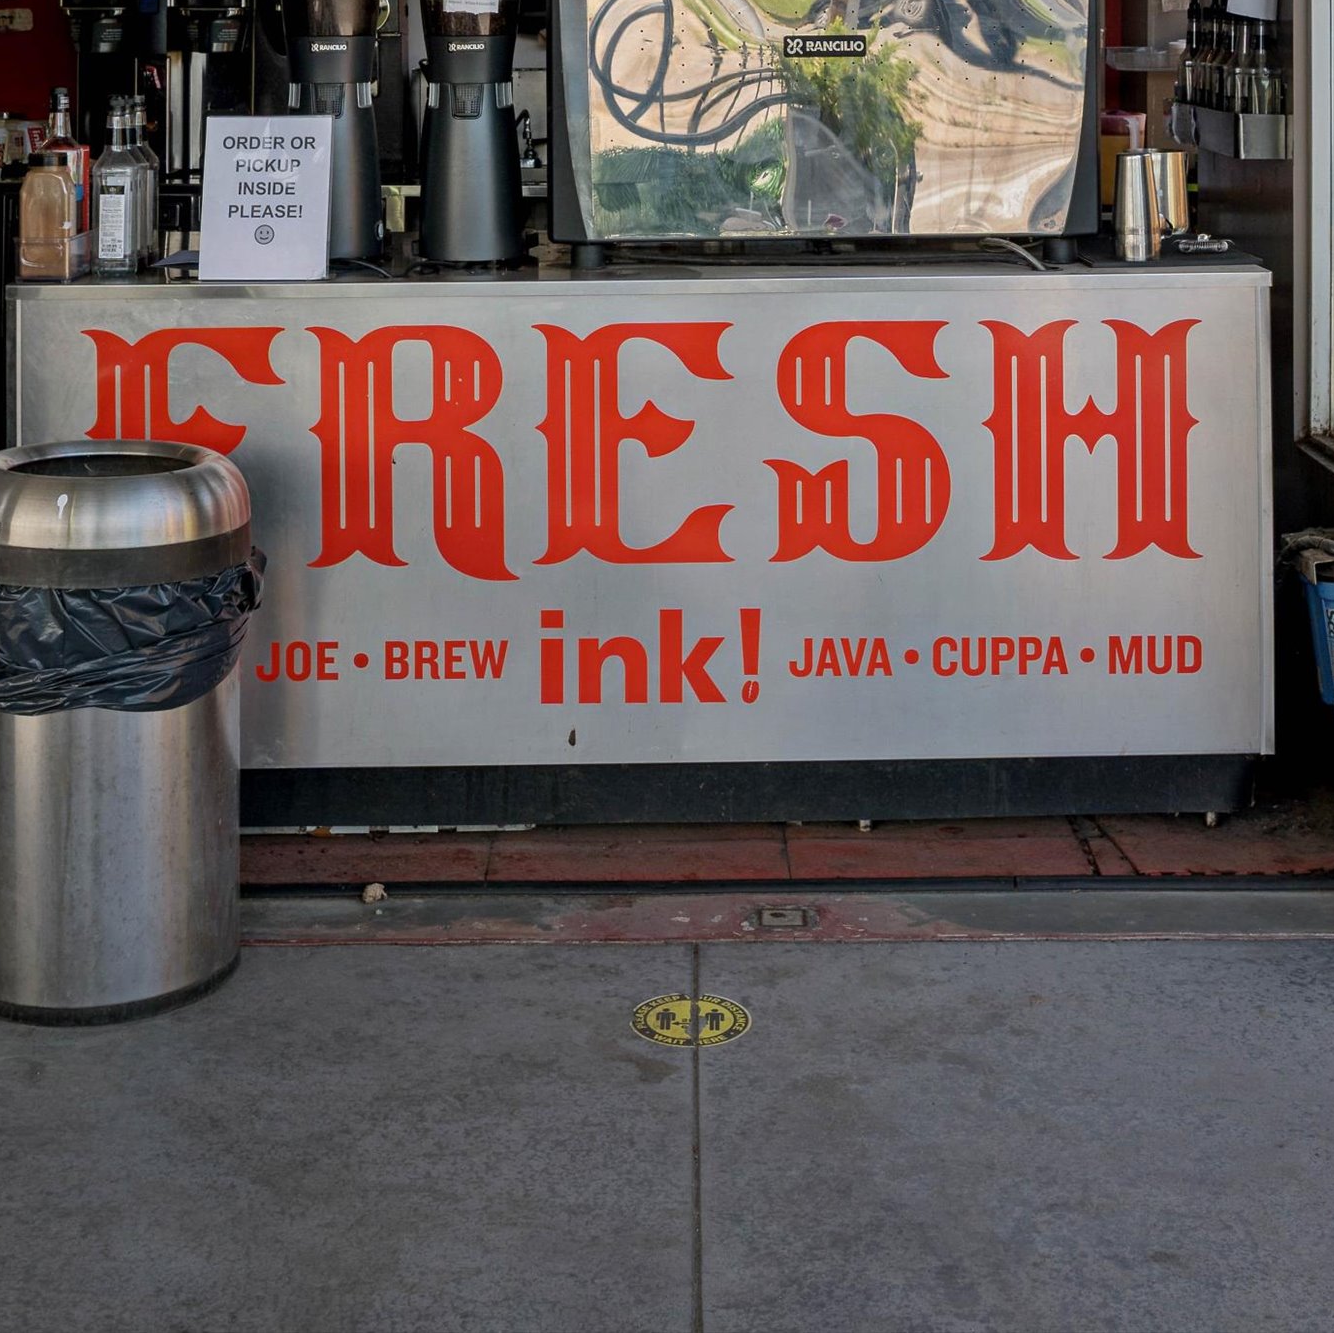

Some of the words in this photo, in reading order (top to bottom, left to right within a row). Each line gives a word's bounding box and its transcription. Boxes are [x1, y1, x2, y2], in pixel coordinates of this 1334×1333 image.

[806, 40, 864, 52] RANCILIO
[223, 136, 285, 149] ORDER
[290, 136, 316, 149] OR
[236, 159, 300, 172] PICKUP
[238, 182, 295, 195] INSIDE
[228, 205, 303, 218] PLEASE!
[80, 319, 1203, 581] FRESH
[255, 641, 339, 682] JOE
[384, 640, 508, 680] BREW
[540, 607, 761, 705] ink!
[789, 637, 892, 678] JAVA
[931, 636, 1070, 677] CUPPA
[1108, 634, 1203, 675] MUD
[651, 995, 680, 1008] KEEP
[721, 1000, 748, 1032] DISTANCE
[653, 1033, 687, 1046] WAIT
